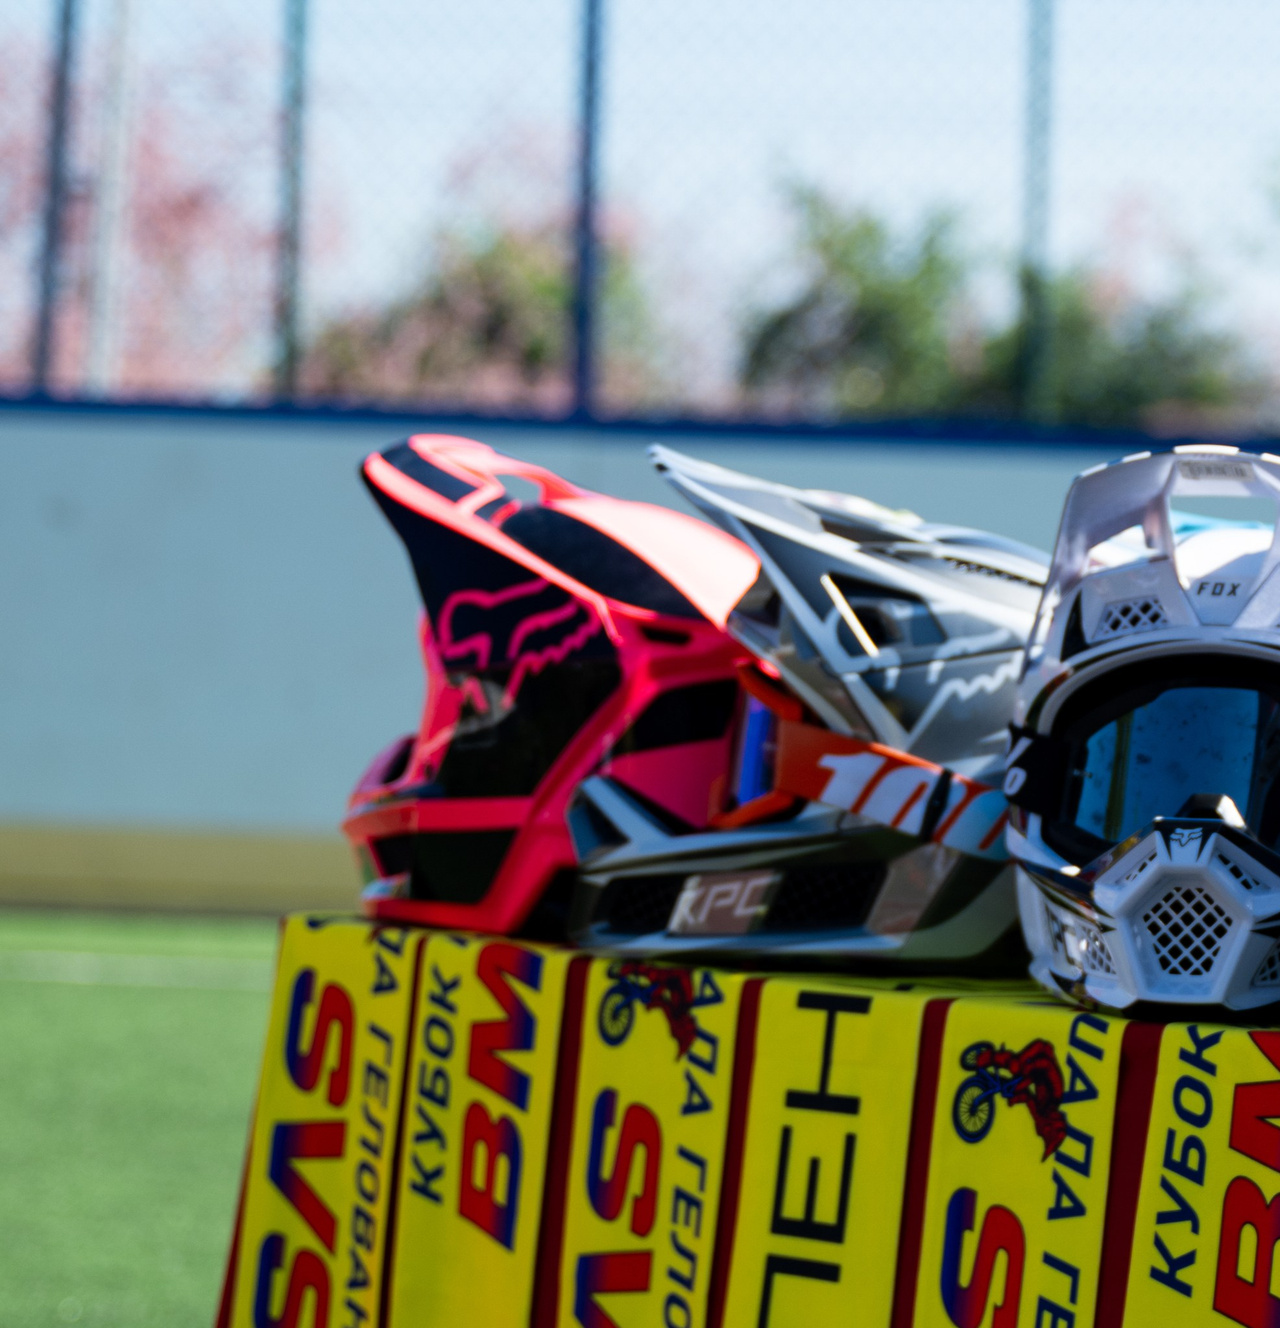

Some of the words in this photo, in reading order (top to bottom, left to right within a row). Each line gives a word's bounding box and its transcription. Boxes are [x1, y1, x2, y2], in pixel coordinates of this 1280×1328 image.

[1197, 582, 1241, 597] FOX
[409, 964, 462, 1205] КУБОК
[1149, 1025, 1225, 1298] КУБОК
